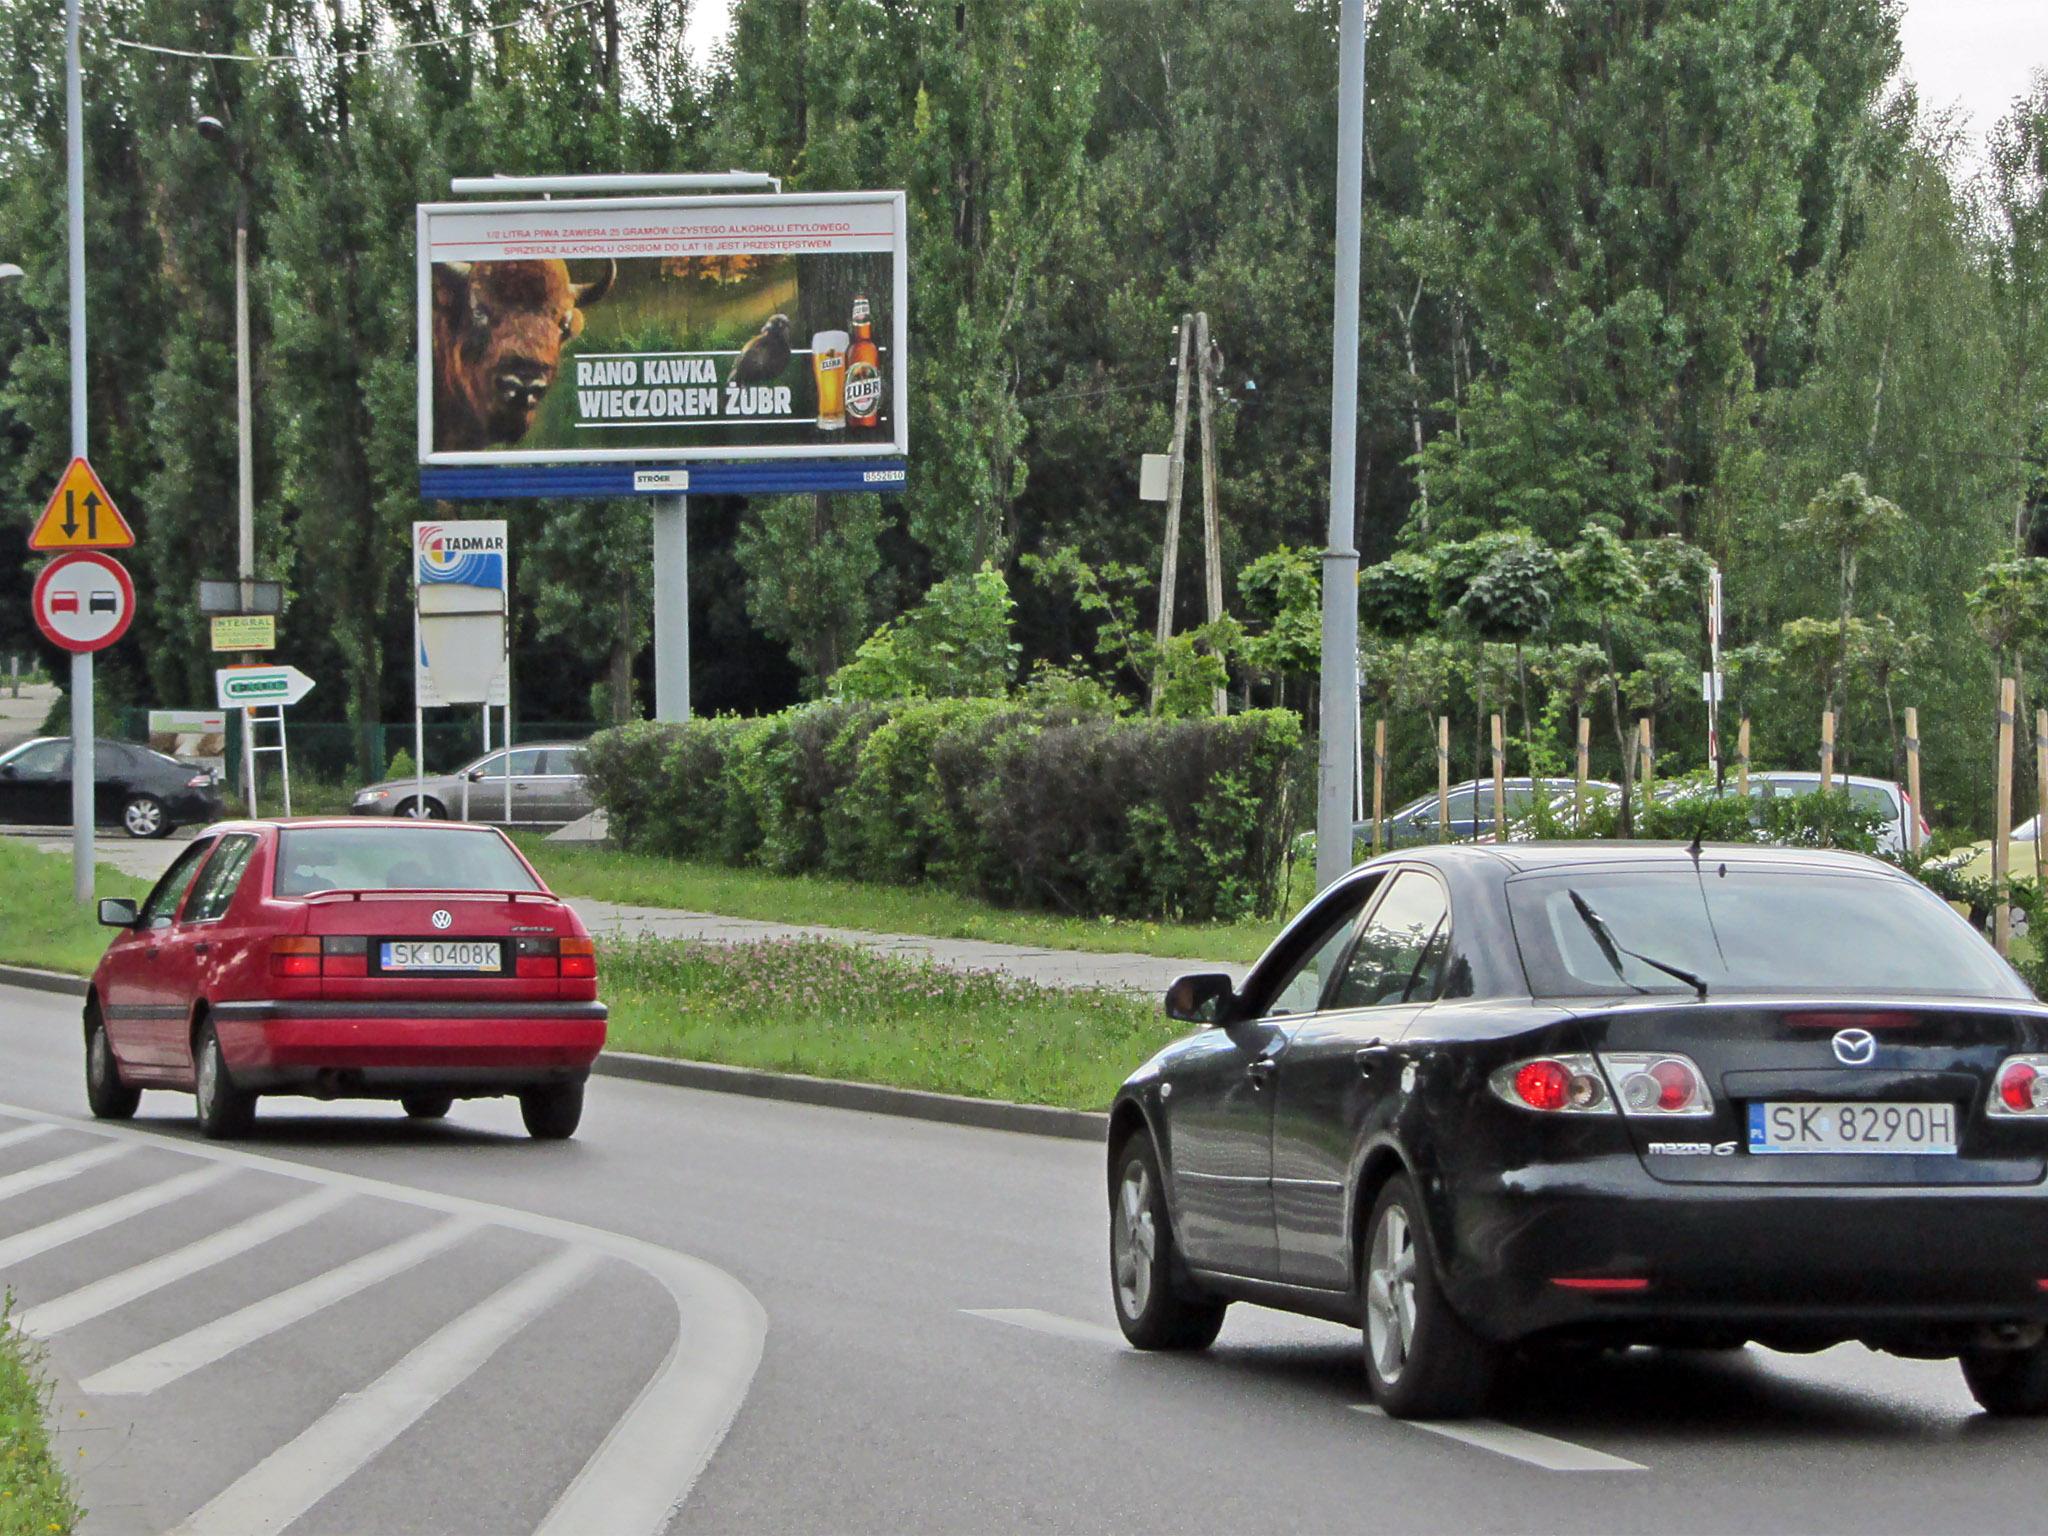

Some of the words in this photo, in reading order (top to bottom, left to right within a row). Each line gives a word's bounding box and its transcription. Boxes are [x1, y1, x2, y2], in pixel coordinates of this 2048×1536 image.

[502, 229, 531, 239] LITRA
[534, 228, 560, 238] PIWA
[562, 227, 607, 238] ZAWIERA
[609, 227, 620, 236] 25
[672, 225, 726, 235] CZYSTEGO
[728, 224, 784, 234] ALKOHOLU
[787, 222, 850, 232] ETYLOWEGO
[560, 244, 612, 254] ALKOHOLU
[616, 244, 660, 253] OSOBOM
[664, 243, 680, 252] DO
[682, 242, 700, 251] LAT
[703, 242, 714, 250] 18
[716, 241, 742, 250] JEST
[577, 361, 637, 386] RANO
[643, 359, 717, 385] KAWKA
[577, 388, 718, 418] WIECZOREM
[725, 382, 792, 415] ŻUBR
[445, 537, 504, 550] TADMAR
[395, 944, 424, 964] SK
[433, 944, 496, 965] 0408K
[1750, 1129, 1764, 1139] PL
[1773, 1107, 1823, 1142] SK
[1839, 1107, 1950, 1142] 8290H
